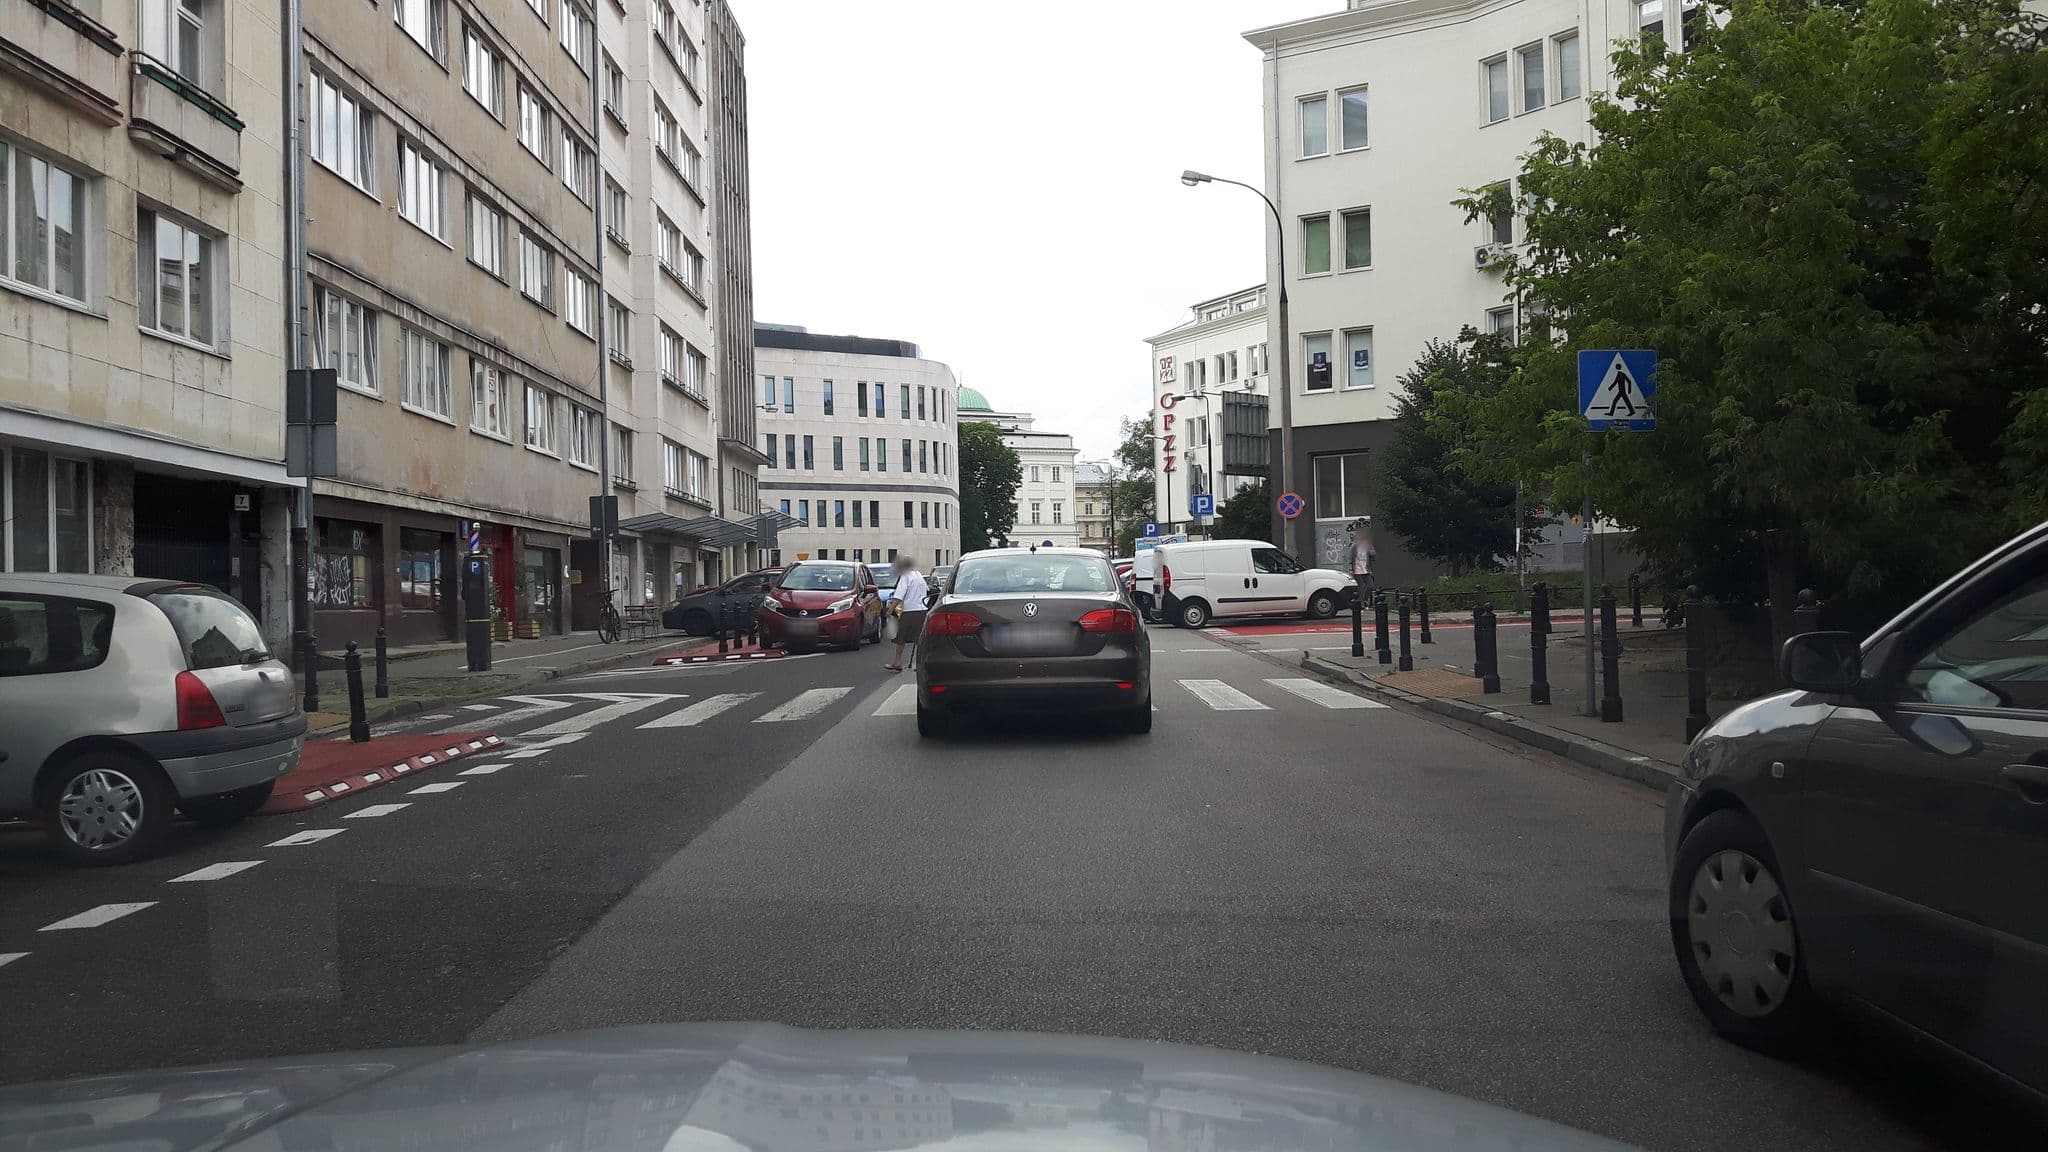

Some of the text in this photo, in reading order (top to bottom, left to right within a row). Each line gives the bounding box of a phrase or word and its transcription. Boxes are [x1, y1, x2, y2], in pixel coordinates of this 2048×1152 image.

[1160, 392, 1177, 473] OPZZ
[239, 496, 246, 505] 7
[1197, 497, 1209, 513] P
[1146, 523, 1156, 536] P
[471, 561, 479, 573] P
